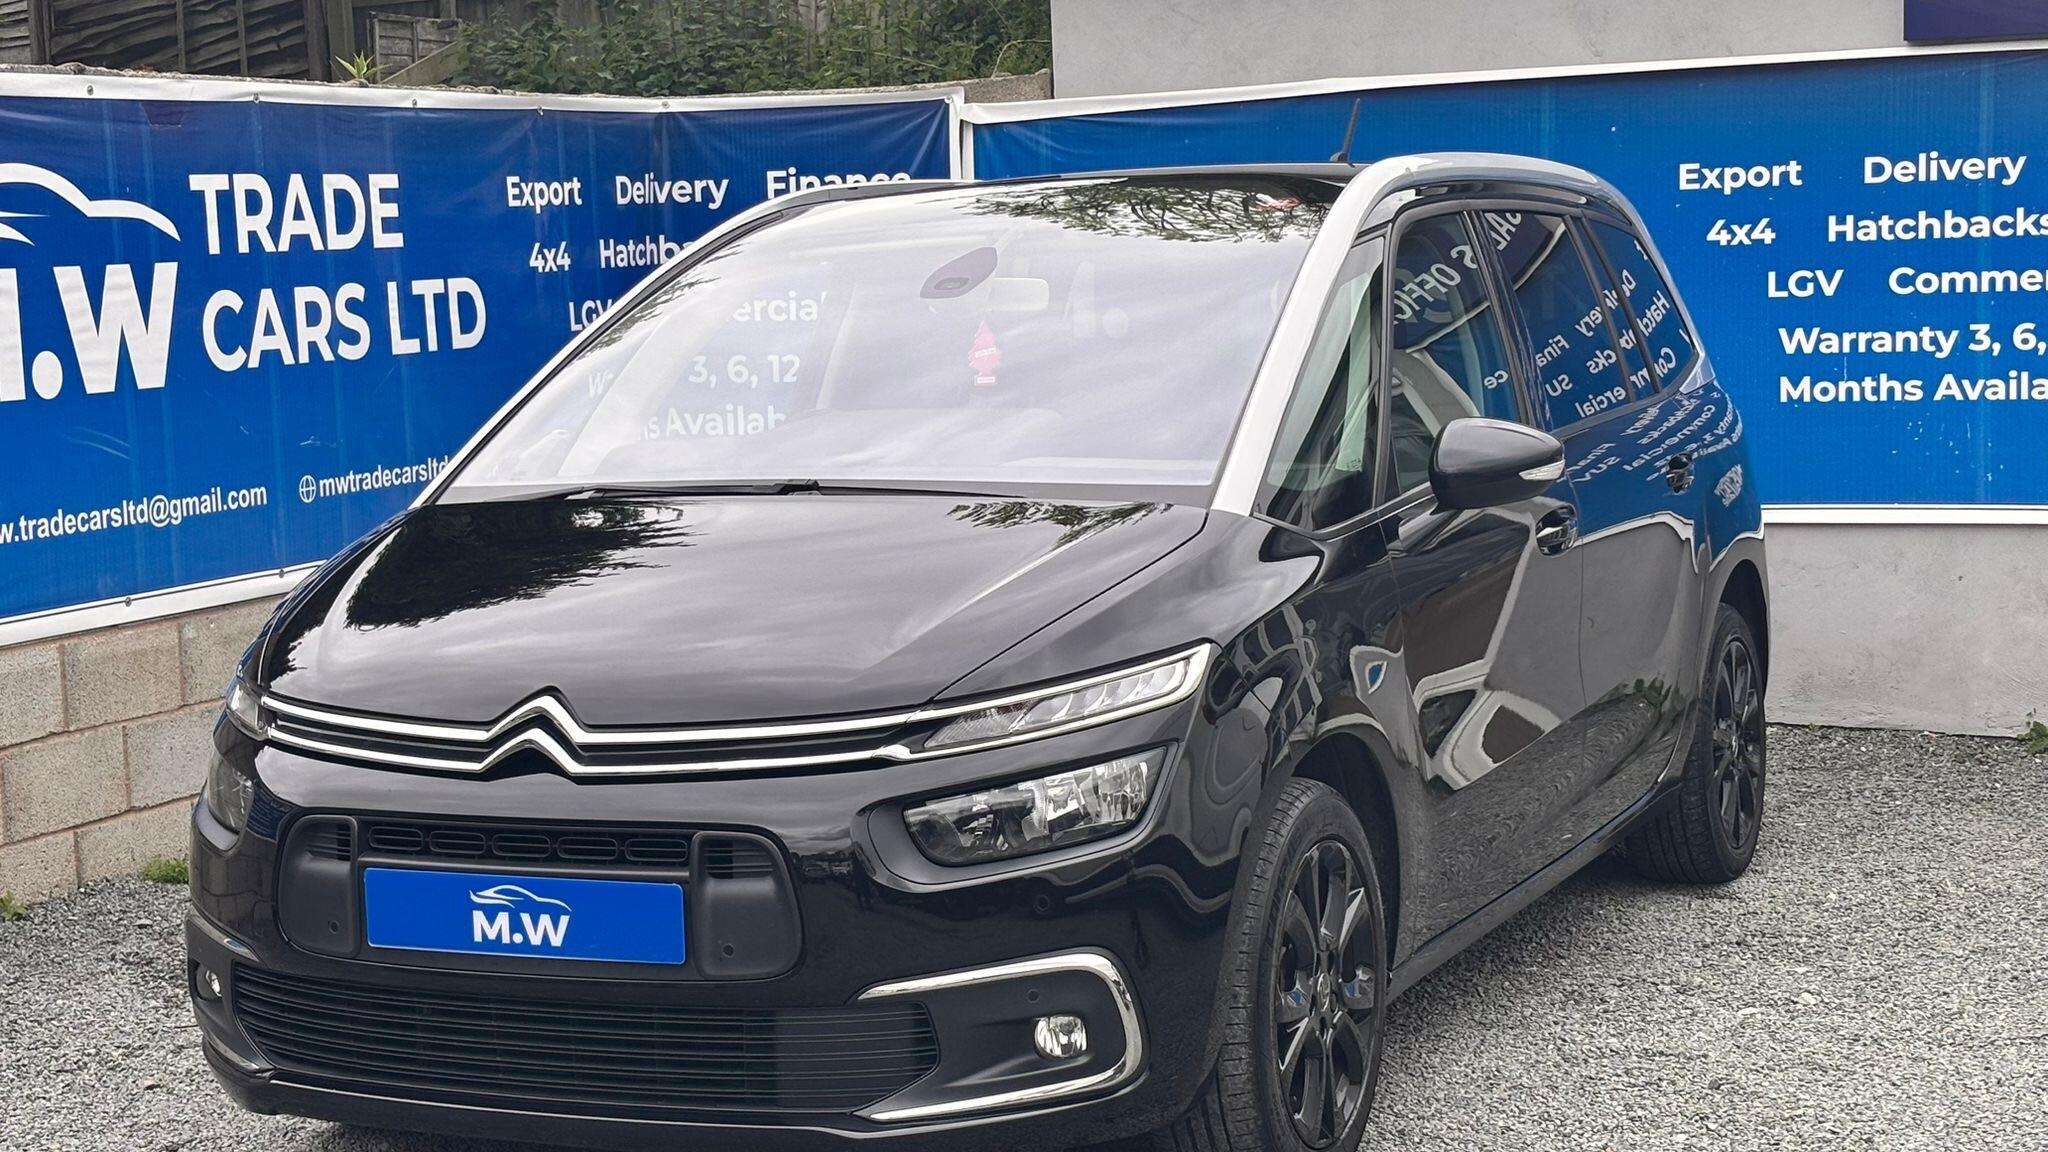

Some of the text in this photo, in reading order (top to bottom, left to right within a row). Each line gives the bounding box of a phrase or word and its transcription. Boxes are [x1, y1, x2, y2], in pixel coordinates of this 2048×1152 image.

[1678, 151, 2027, 195] Export Delivery
[506, 175, 582, 214] Export
[615, 172, 729, 210] Delivery
[188, 173, 404, 256] TRADE
[1706, 217, 1776, 246] 4x4
[529, 241, 571, 273] 4x4
[1767, 267, 2048, 298] LGV Comme
[0, 262, 179, 402] .W
[202, 276, 488, 372] CARS LTD
[1778, 322, 2046, 358] Warranty 3, 6,
[688, 354, 800, 389] 3, 6, 12
[1779, 373, 1924, 403] Months
[472, 910, 571, 947] M.W
